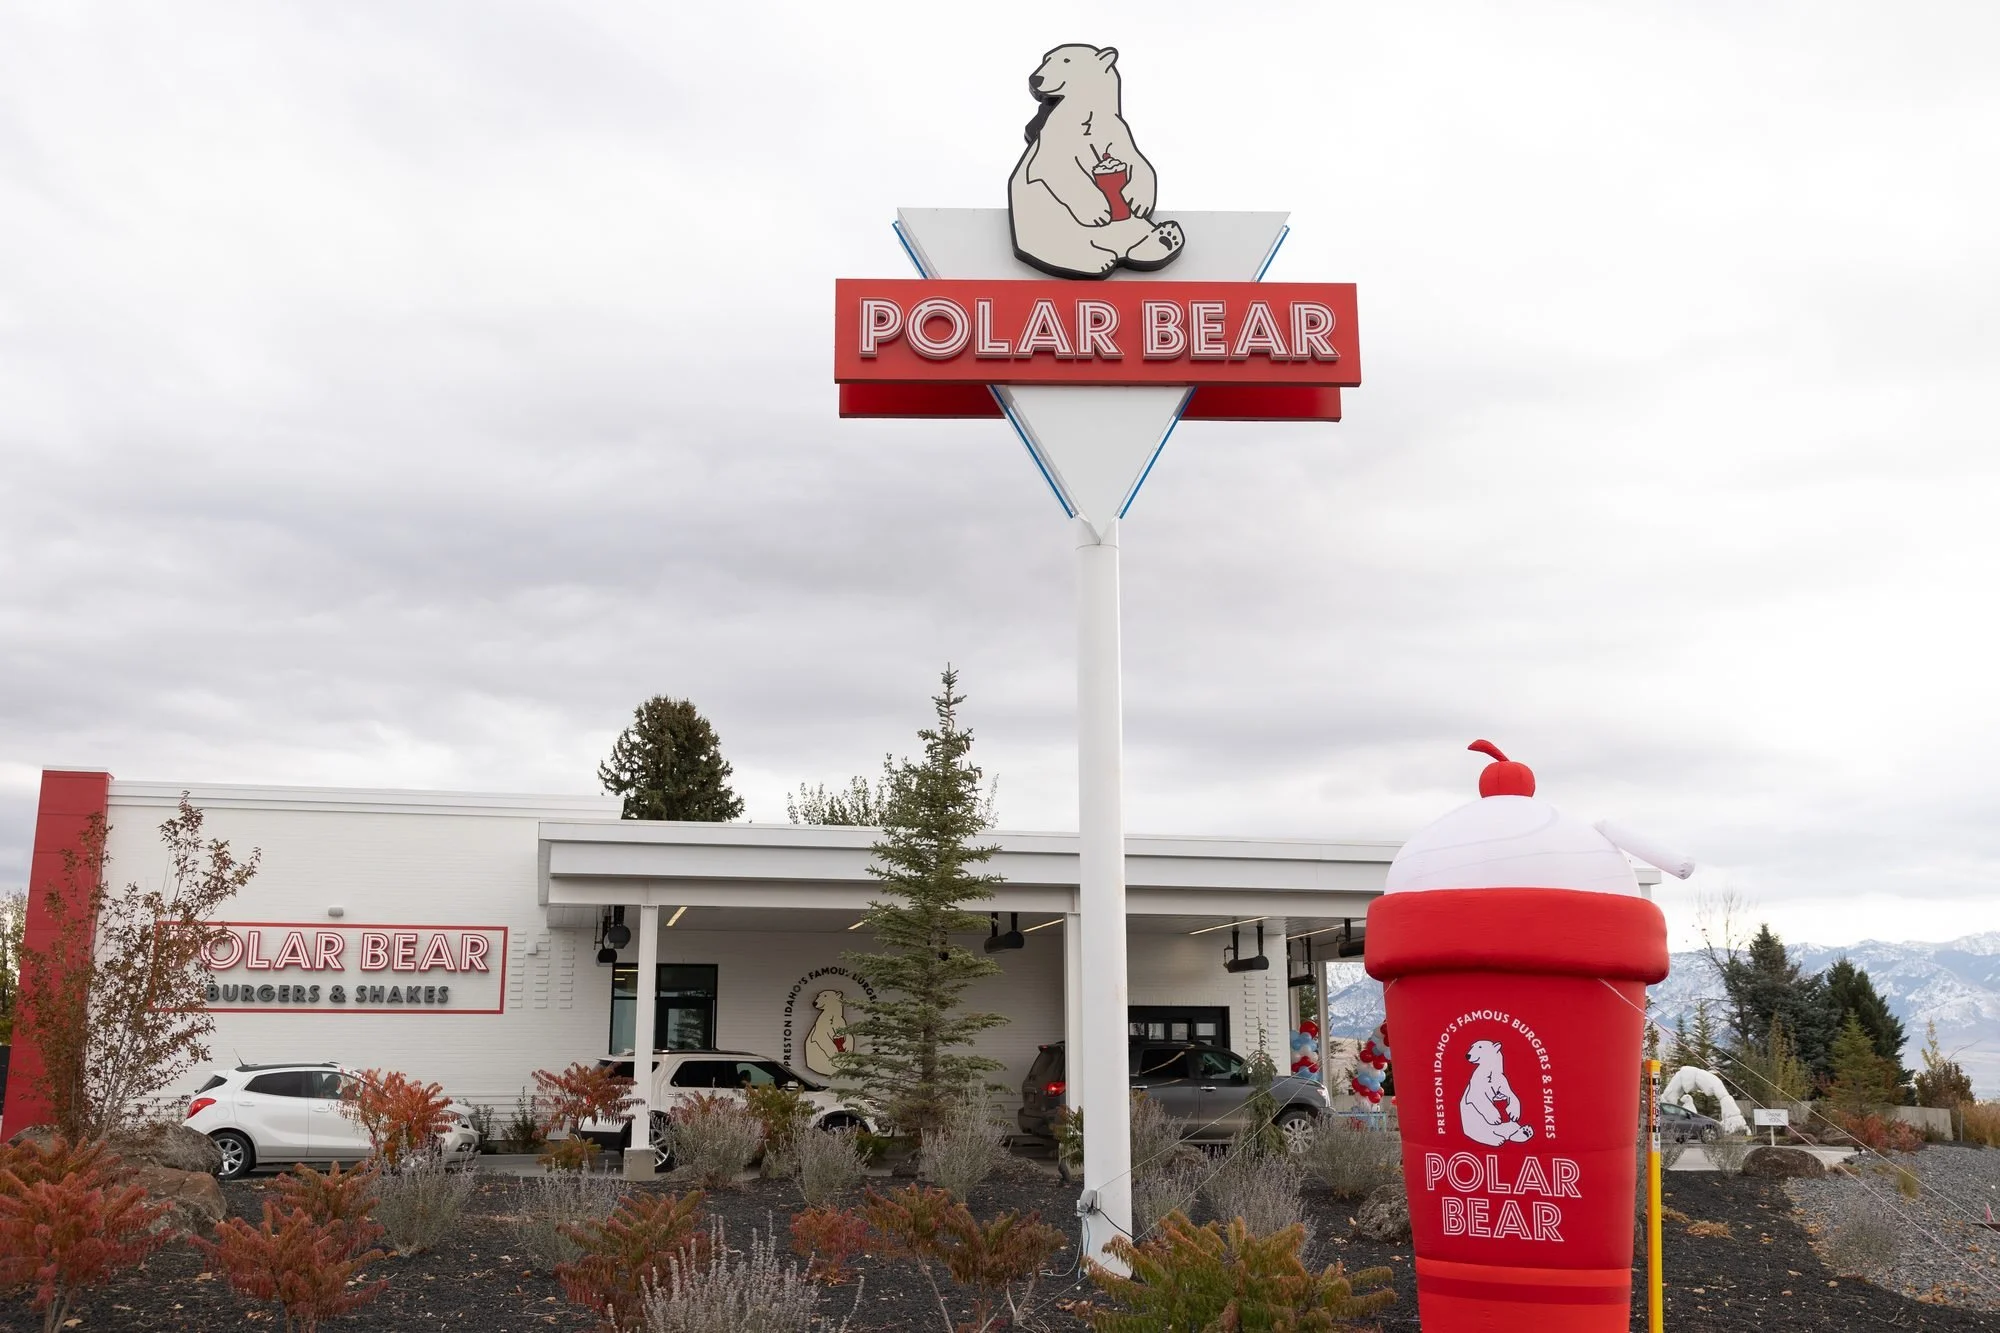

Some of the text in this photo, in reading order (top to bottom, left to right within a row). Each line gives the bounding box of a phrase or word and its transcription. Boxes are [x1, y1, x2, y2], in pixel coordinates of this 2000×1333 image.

[859, 296, 1341, 362] POLAR BEAR
[360, 931, 490, 973] BEAR
[206, 984, 450, 1004] BURGERS & SHAKES
[785, 977, 808, 1017] IDAHO'S
[783, 1020, 792, 1067] PRESTON
[1434, 1010, 1556, 1139] PRESTON IDAHO'S FAMOUS BURGERS & SHAKES
[1425, 1152, 1582, 1198] POLAR
[1441, 1196, 1564, 1242] BEAR
